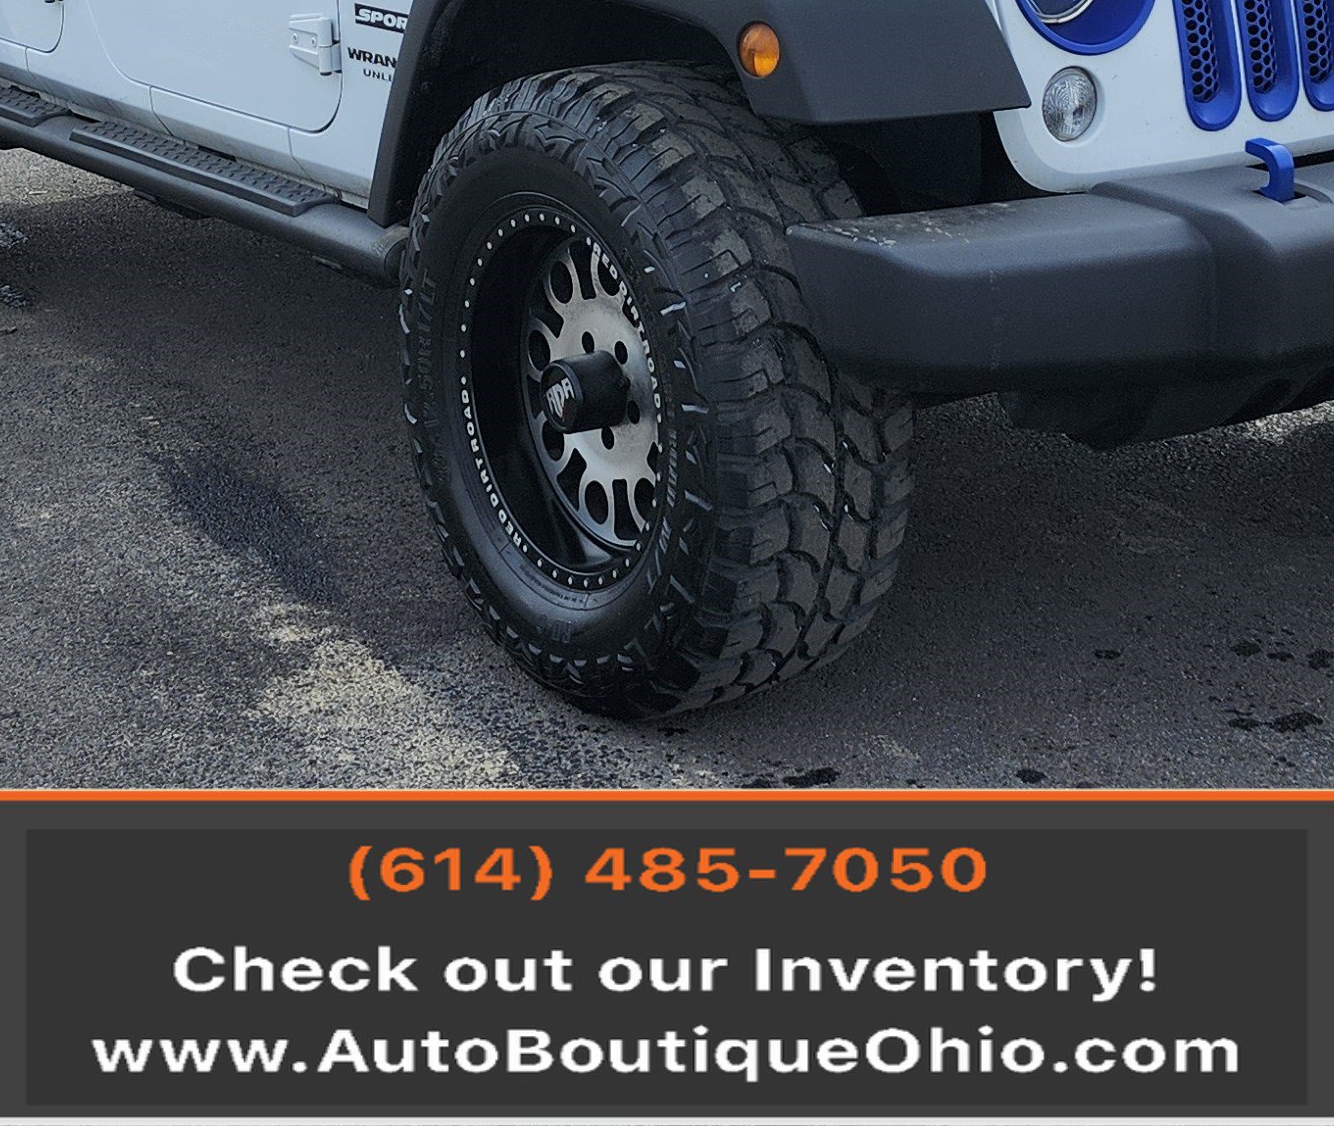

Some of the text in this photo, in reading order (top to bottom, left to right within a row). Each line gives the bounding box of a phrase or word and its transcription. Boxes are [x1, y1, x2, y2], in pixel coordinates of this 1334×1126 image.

[347, 47, 397, 68] WRAN
[363, 68, 392, 82] UNLI
[461, 389, 480, 453] ROAD
